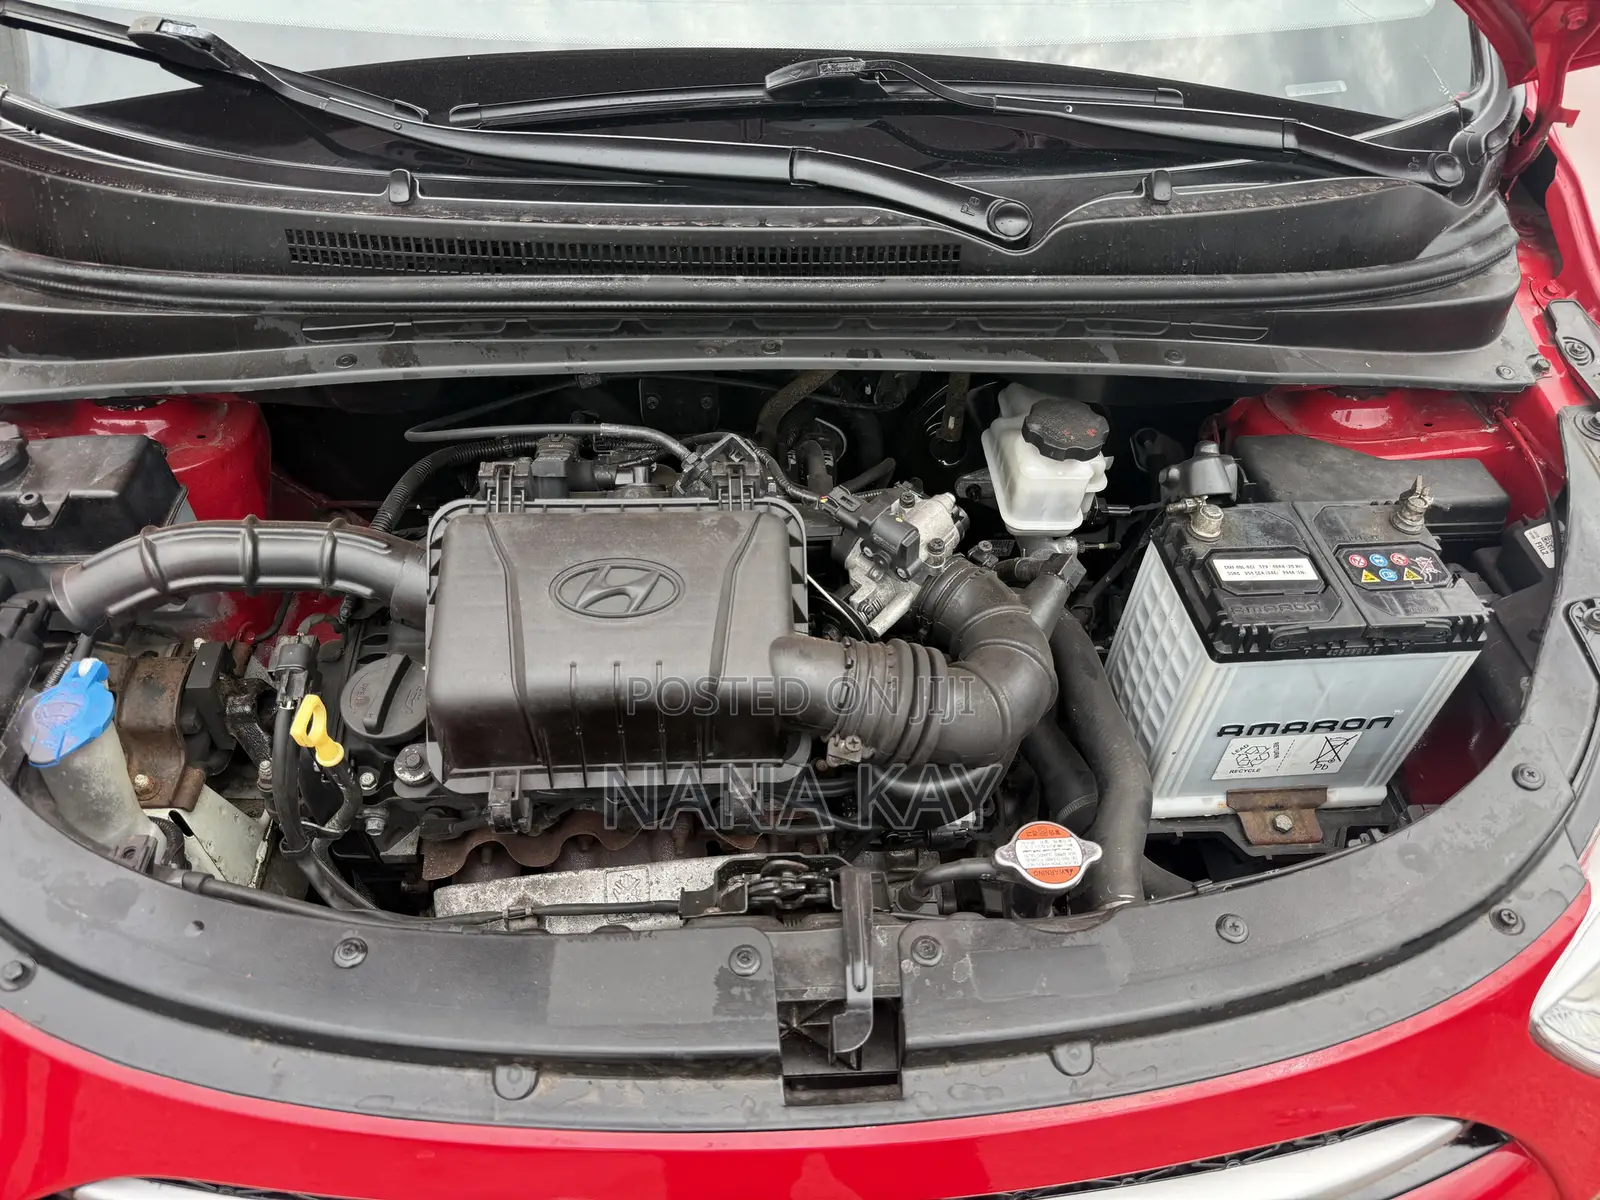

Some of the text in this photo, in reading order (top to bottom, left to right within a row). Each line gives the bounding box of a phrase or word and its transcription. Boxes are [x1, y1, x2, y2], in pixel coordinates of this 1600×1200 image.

[1229, 602, 1322, 615] AMARON
[1217, 716, 1395, 737] AMARON
[1231, 744, 1250, 755] LEAD
[1312, 763, 1329, 771] Pb
